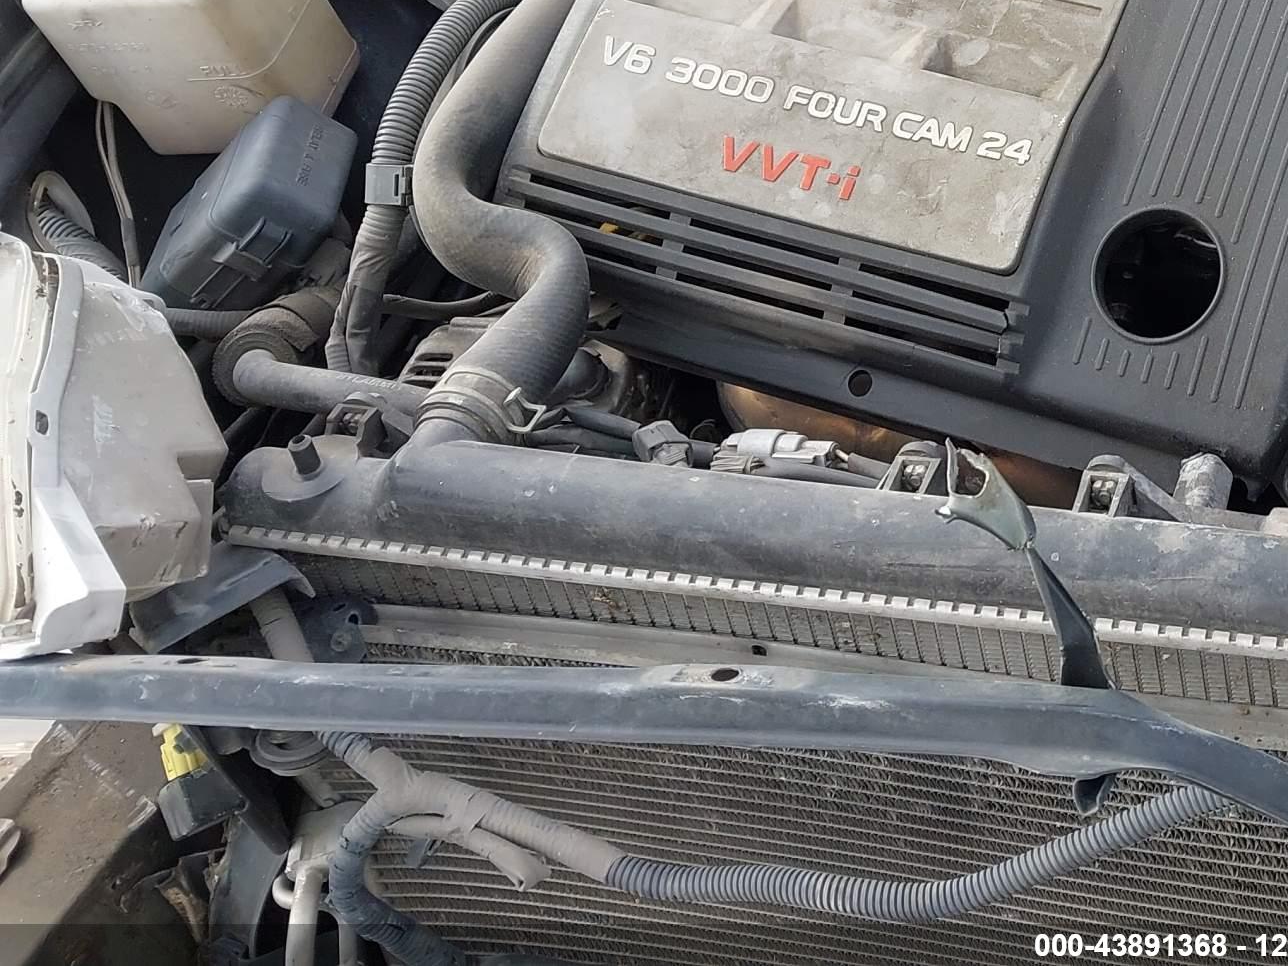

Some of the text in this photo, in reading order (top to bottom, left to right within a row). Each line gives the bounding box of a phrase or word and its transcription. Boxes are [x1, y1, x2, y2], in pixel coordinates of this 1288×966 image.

[603, 35, 1033, 166] V6 3000 FOUR CAM 24
